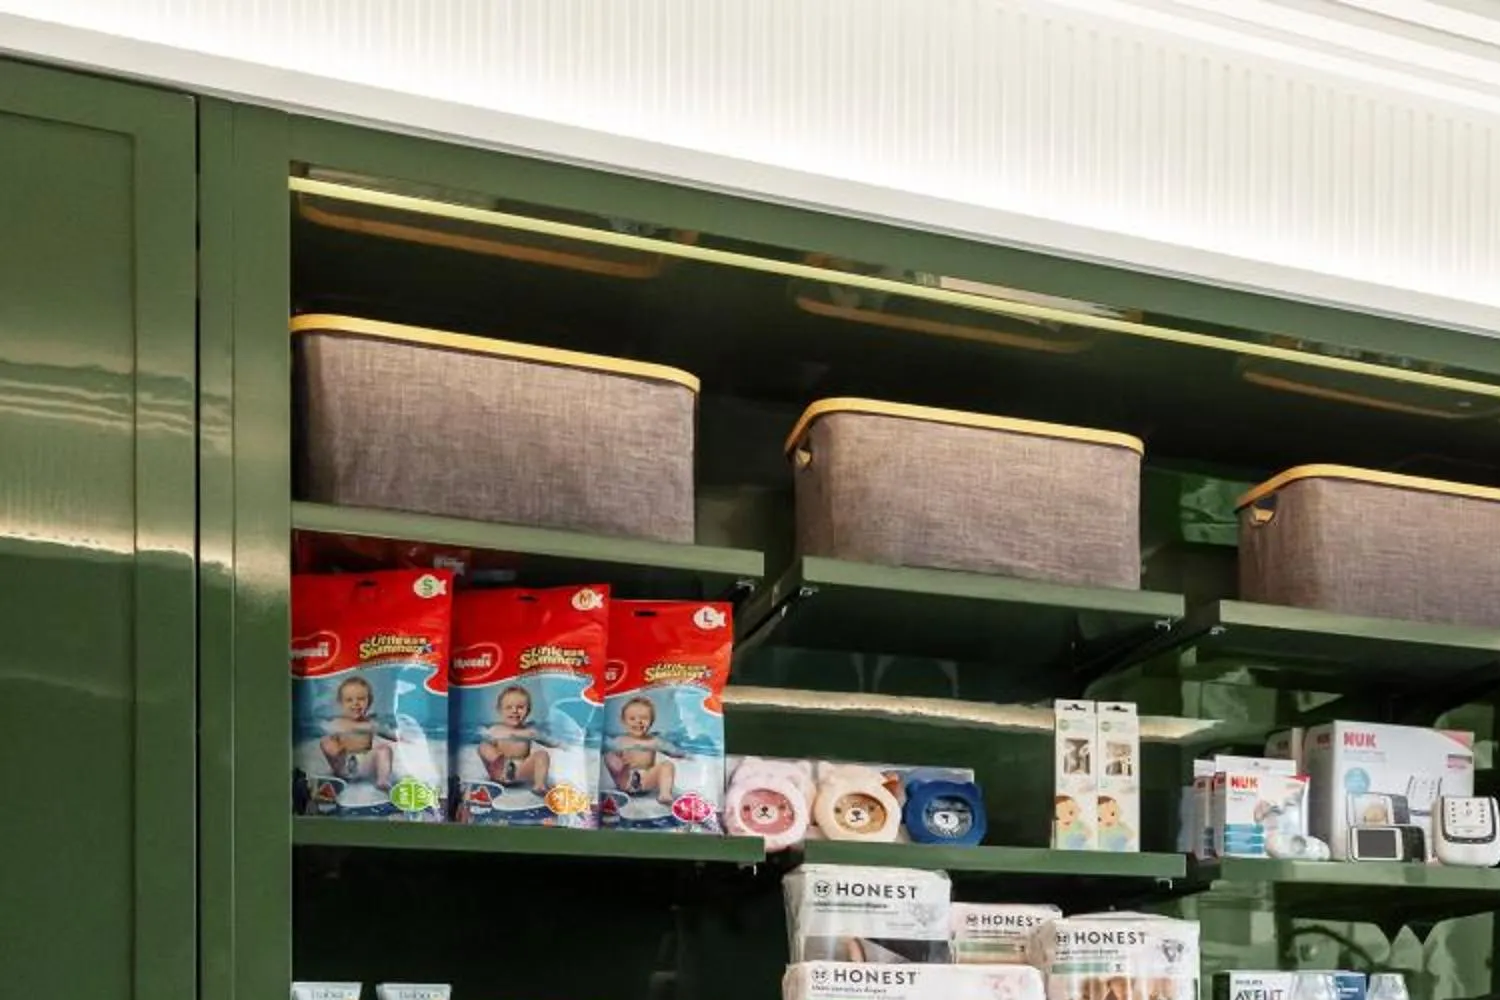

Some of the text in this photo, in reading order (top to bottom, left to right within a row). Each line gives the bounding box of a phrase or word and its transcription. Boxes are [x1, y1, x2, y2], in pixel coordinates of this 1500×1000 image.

[422, 579, 433, 591] S
[1343, 731, 1376, 747] NUK
[1231, 776, 1258, 788] NUK
[836, 883, 917, 899] HONEST
[1075, 931, 1146, 944] HONEST
[834, 969, 917, 985] HONEST
